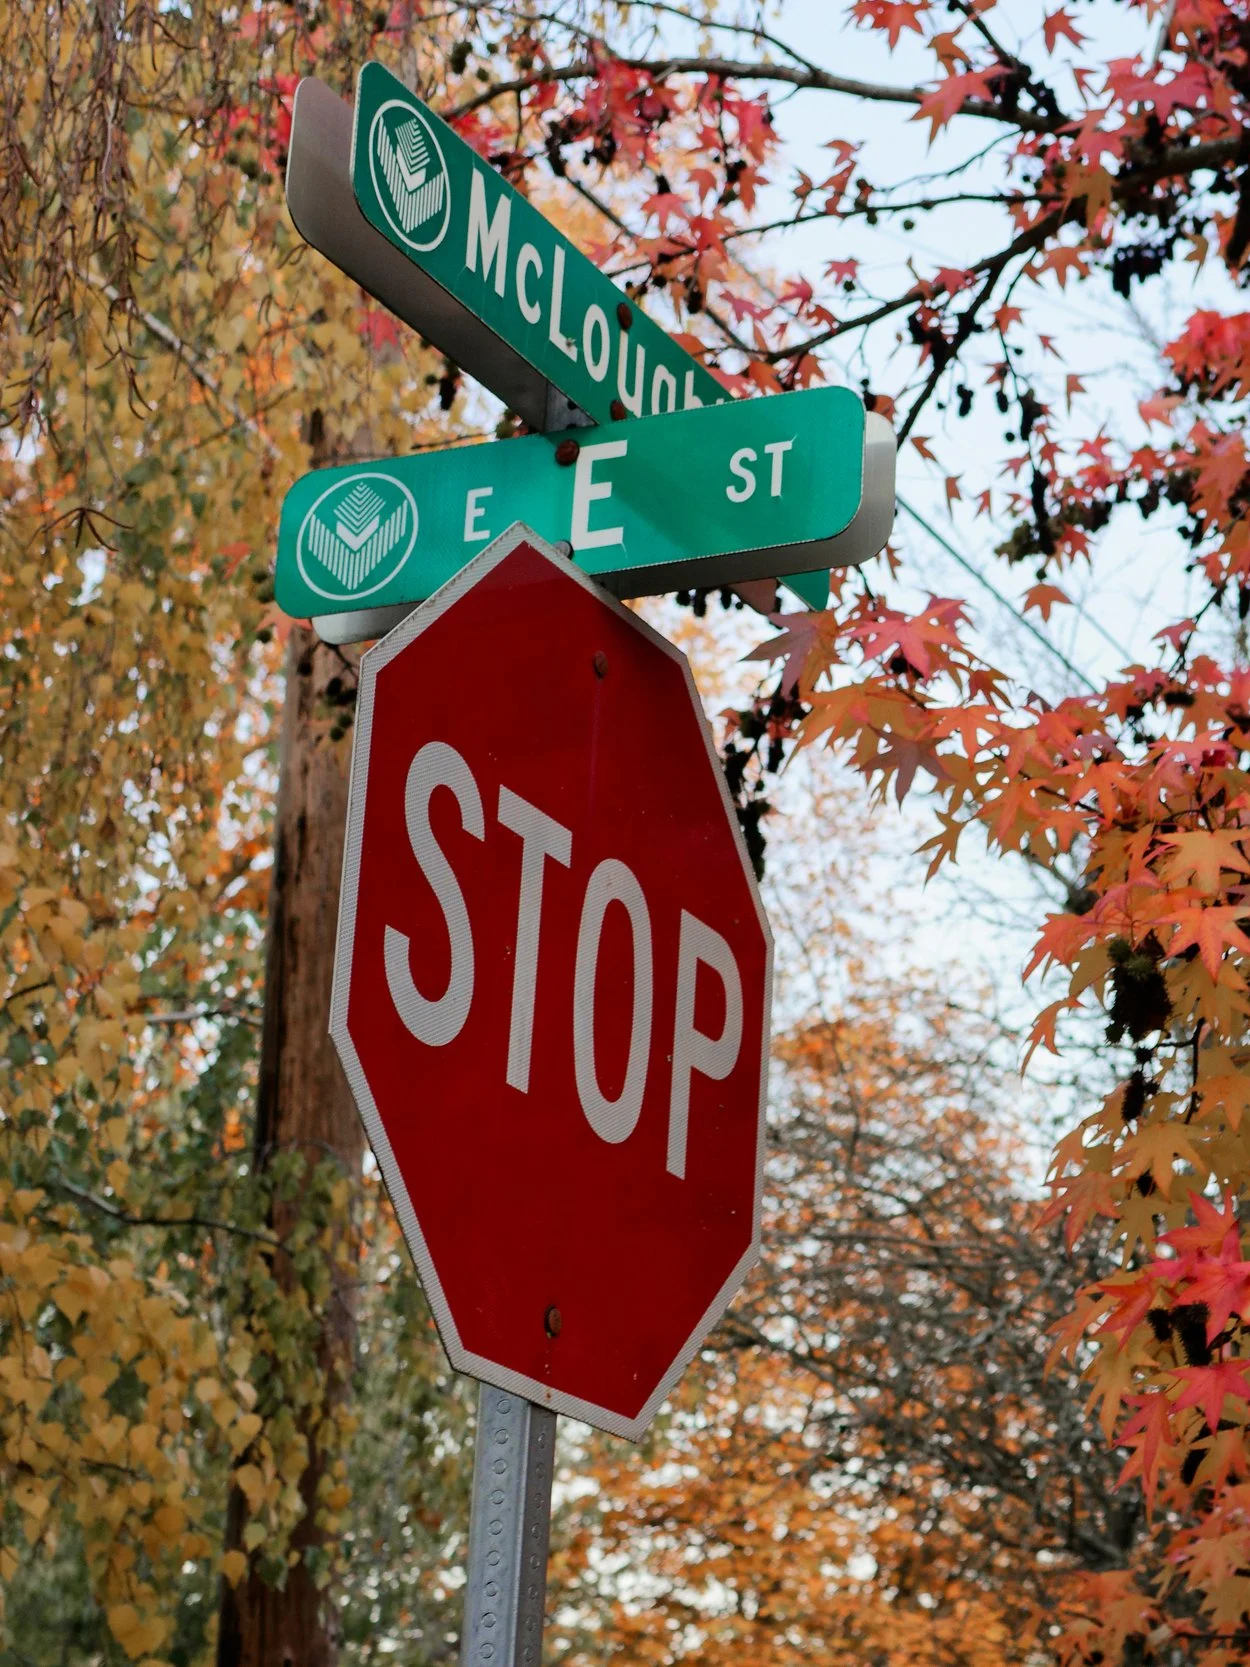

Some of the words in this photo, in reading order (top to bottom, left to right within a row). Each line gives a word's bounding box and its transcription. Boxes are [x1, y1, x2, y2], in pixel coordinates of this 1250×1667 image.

[463, 487, 493, 542] E
[570, 440, 628, 551] E
[725, 441, 794, 503] ST
[384, 742, 742, 1180] STOP
